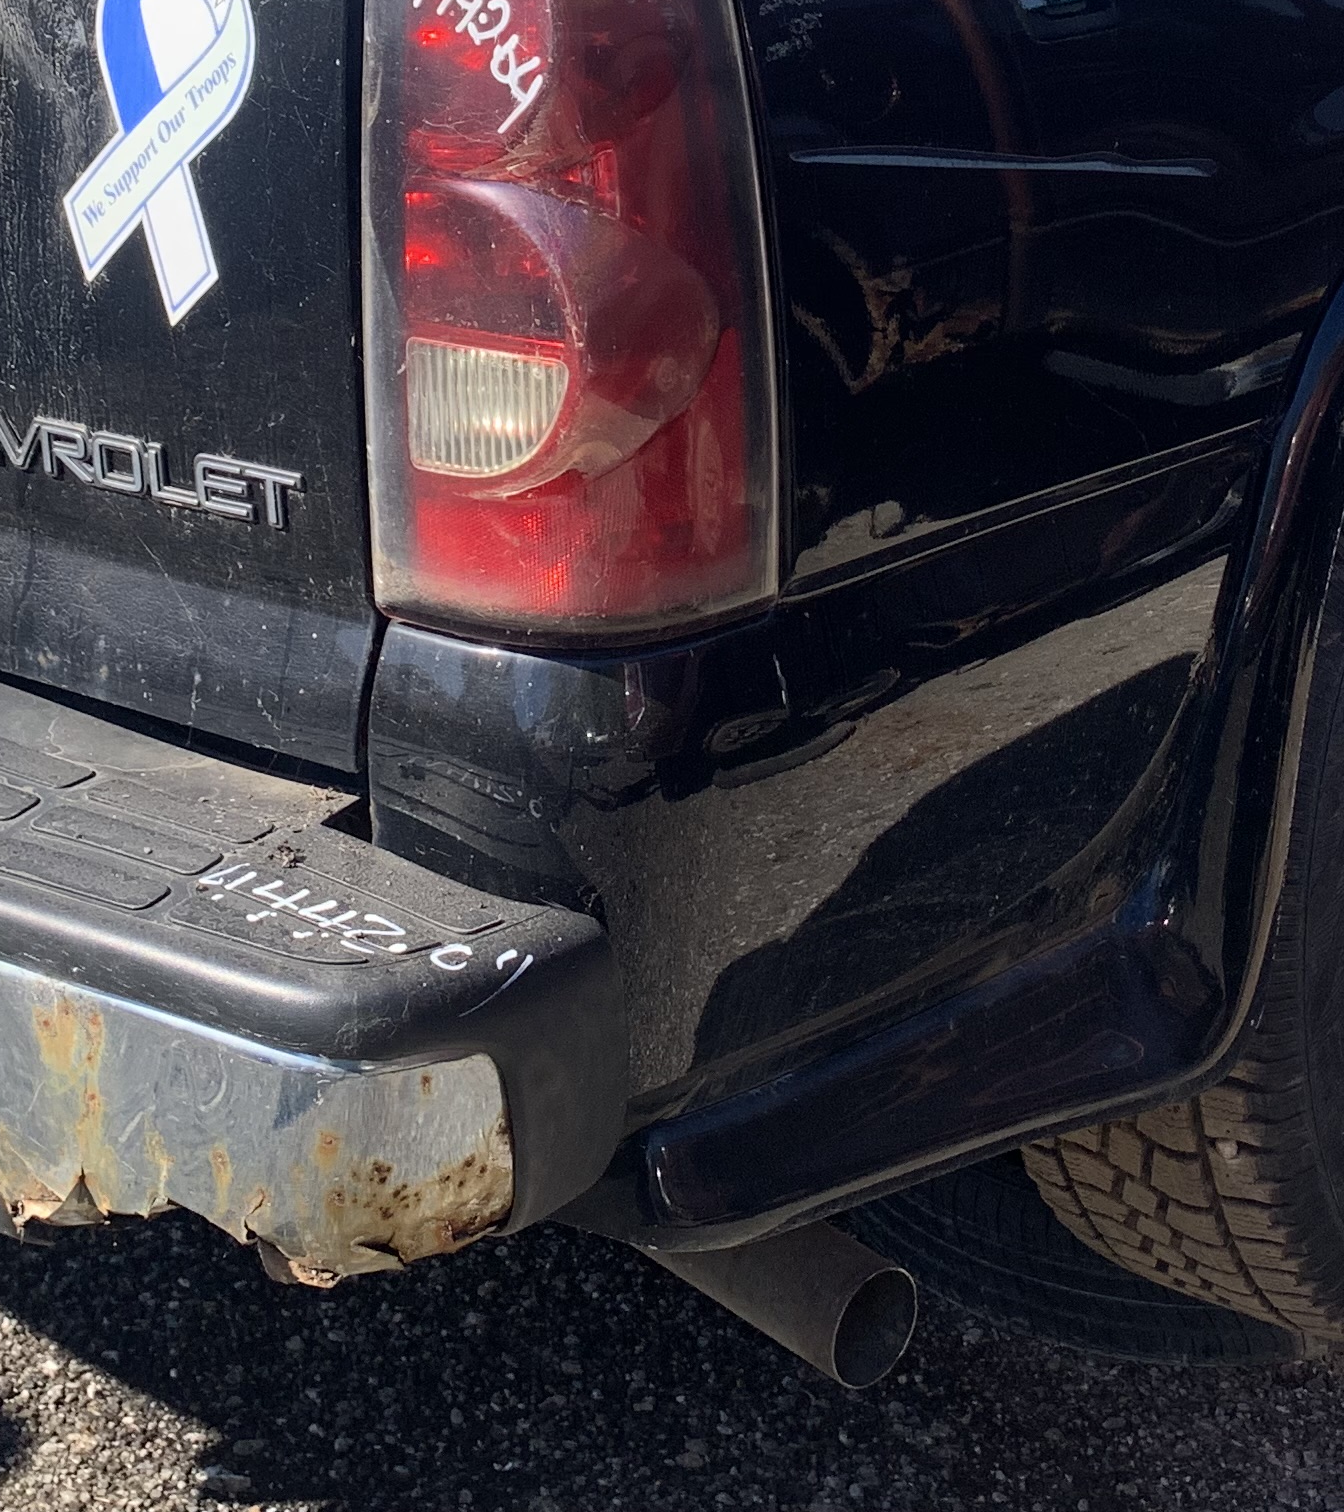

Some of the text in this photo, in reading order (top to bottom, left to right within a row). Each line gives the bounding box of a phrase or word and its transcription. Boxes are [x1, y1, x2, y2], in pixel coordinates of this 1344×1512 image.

[81, 51, 238, 229] We Support Our Troops
